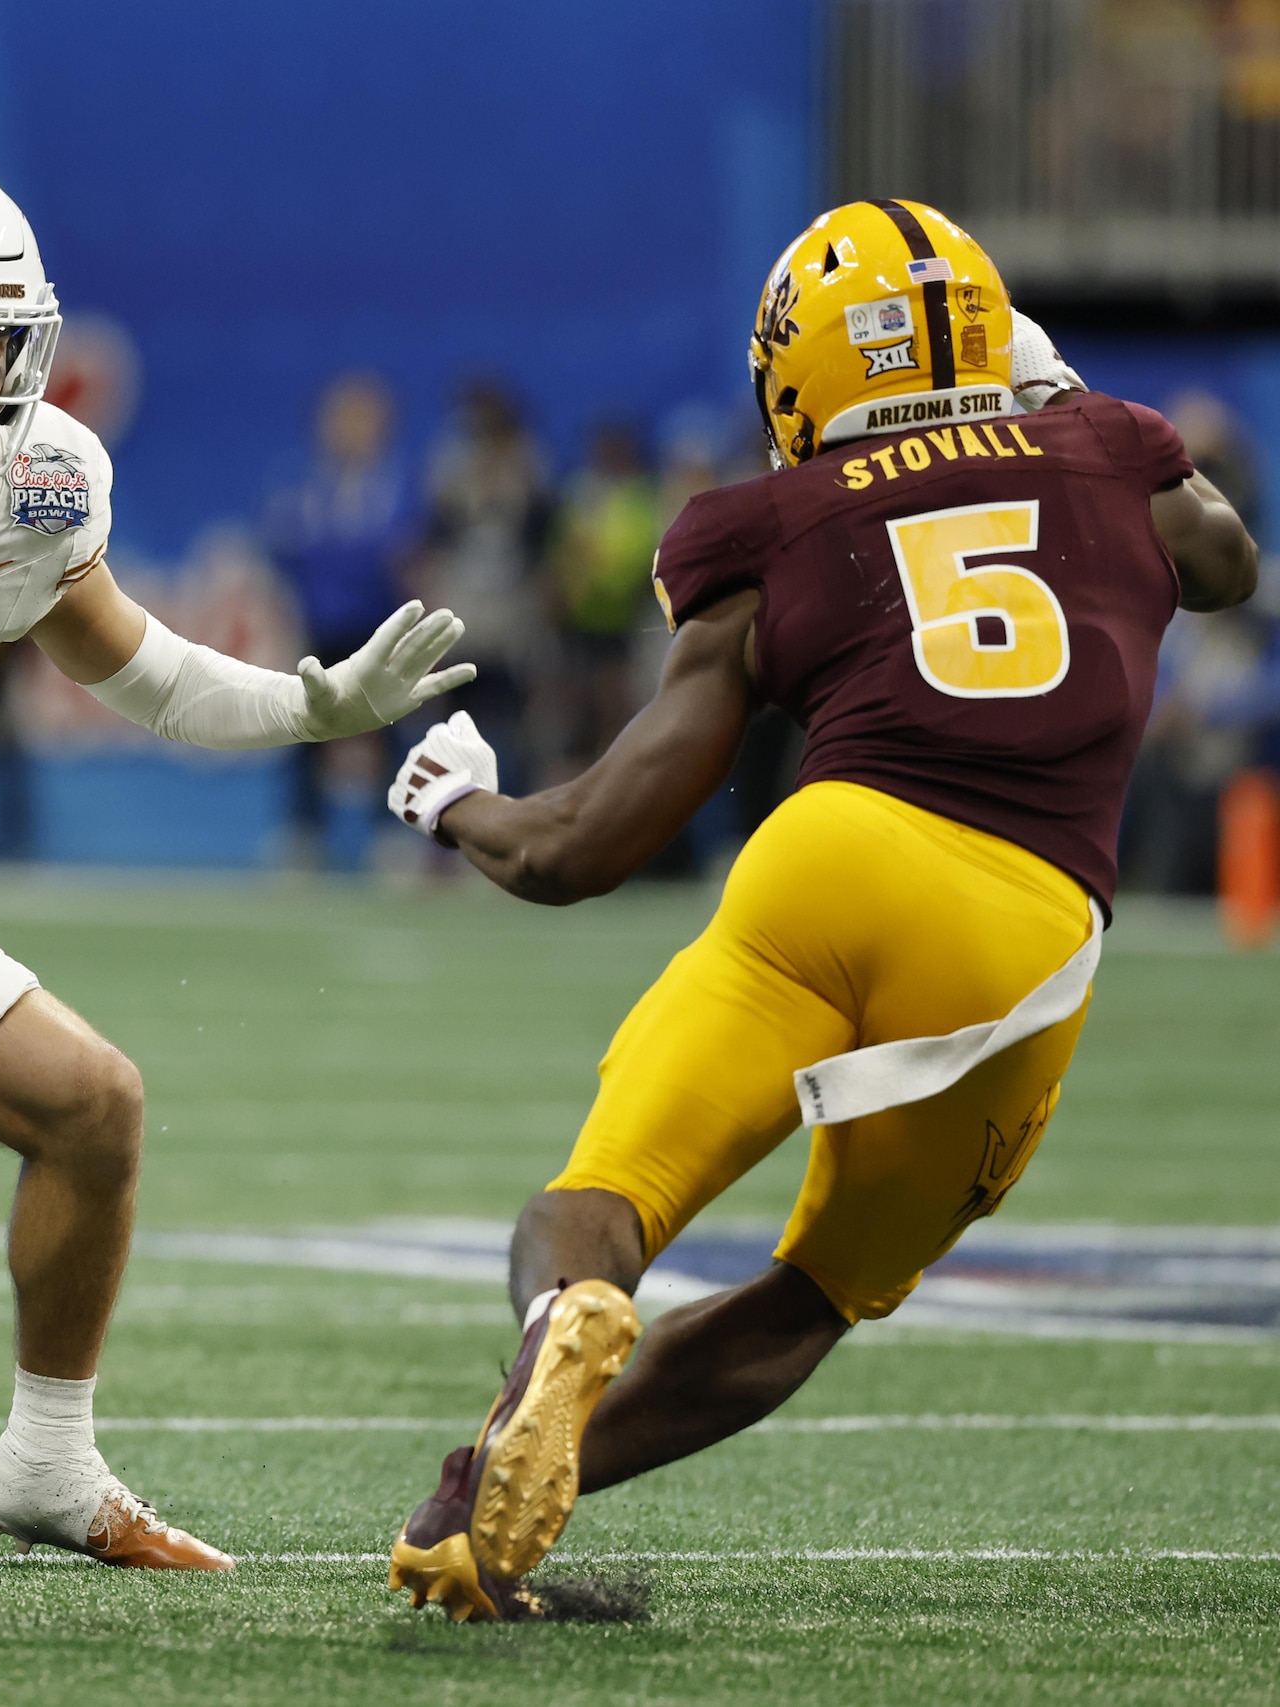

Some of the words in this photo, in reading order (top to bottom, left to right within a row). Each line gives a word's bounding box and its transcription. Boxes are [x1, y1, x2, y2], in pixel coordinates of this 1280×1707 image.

[866, 399, 953, 430] ARIZONA
[960, 393, 1002, 415] STATE
[842, 424, 1044, 490] STOVALL
[11, 460, 87, 490] Chick-fil-A
[13, 488, 88, 512] PEACH
[28, 509, 74, 519] BOWL
[885, 499, 1070, 699] 5
